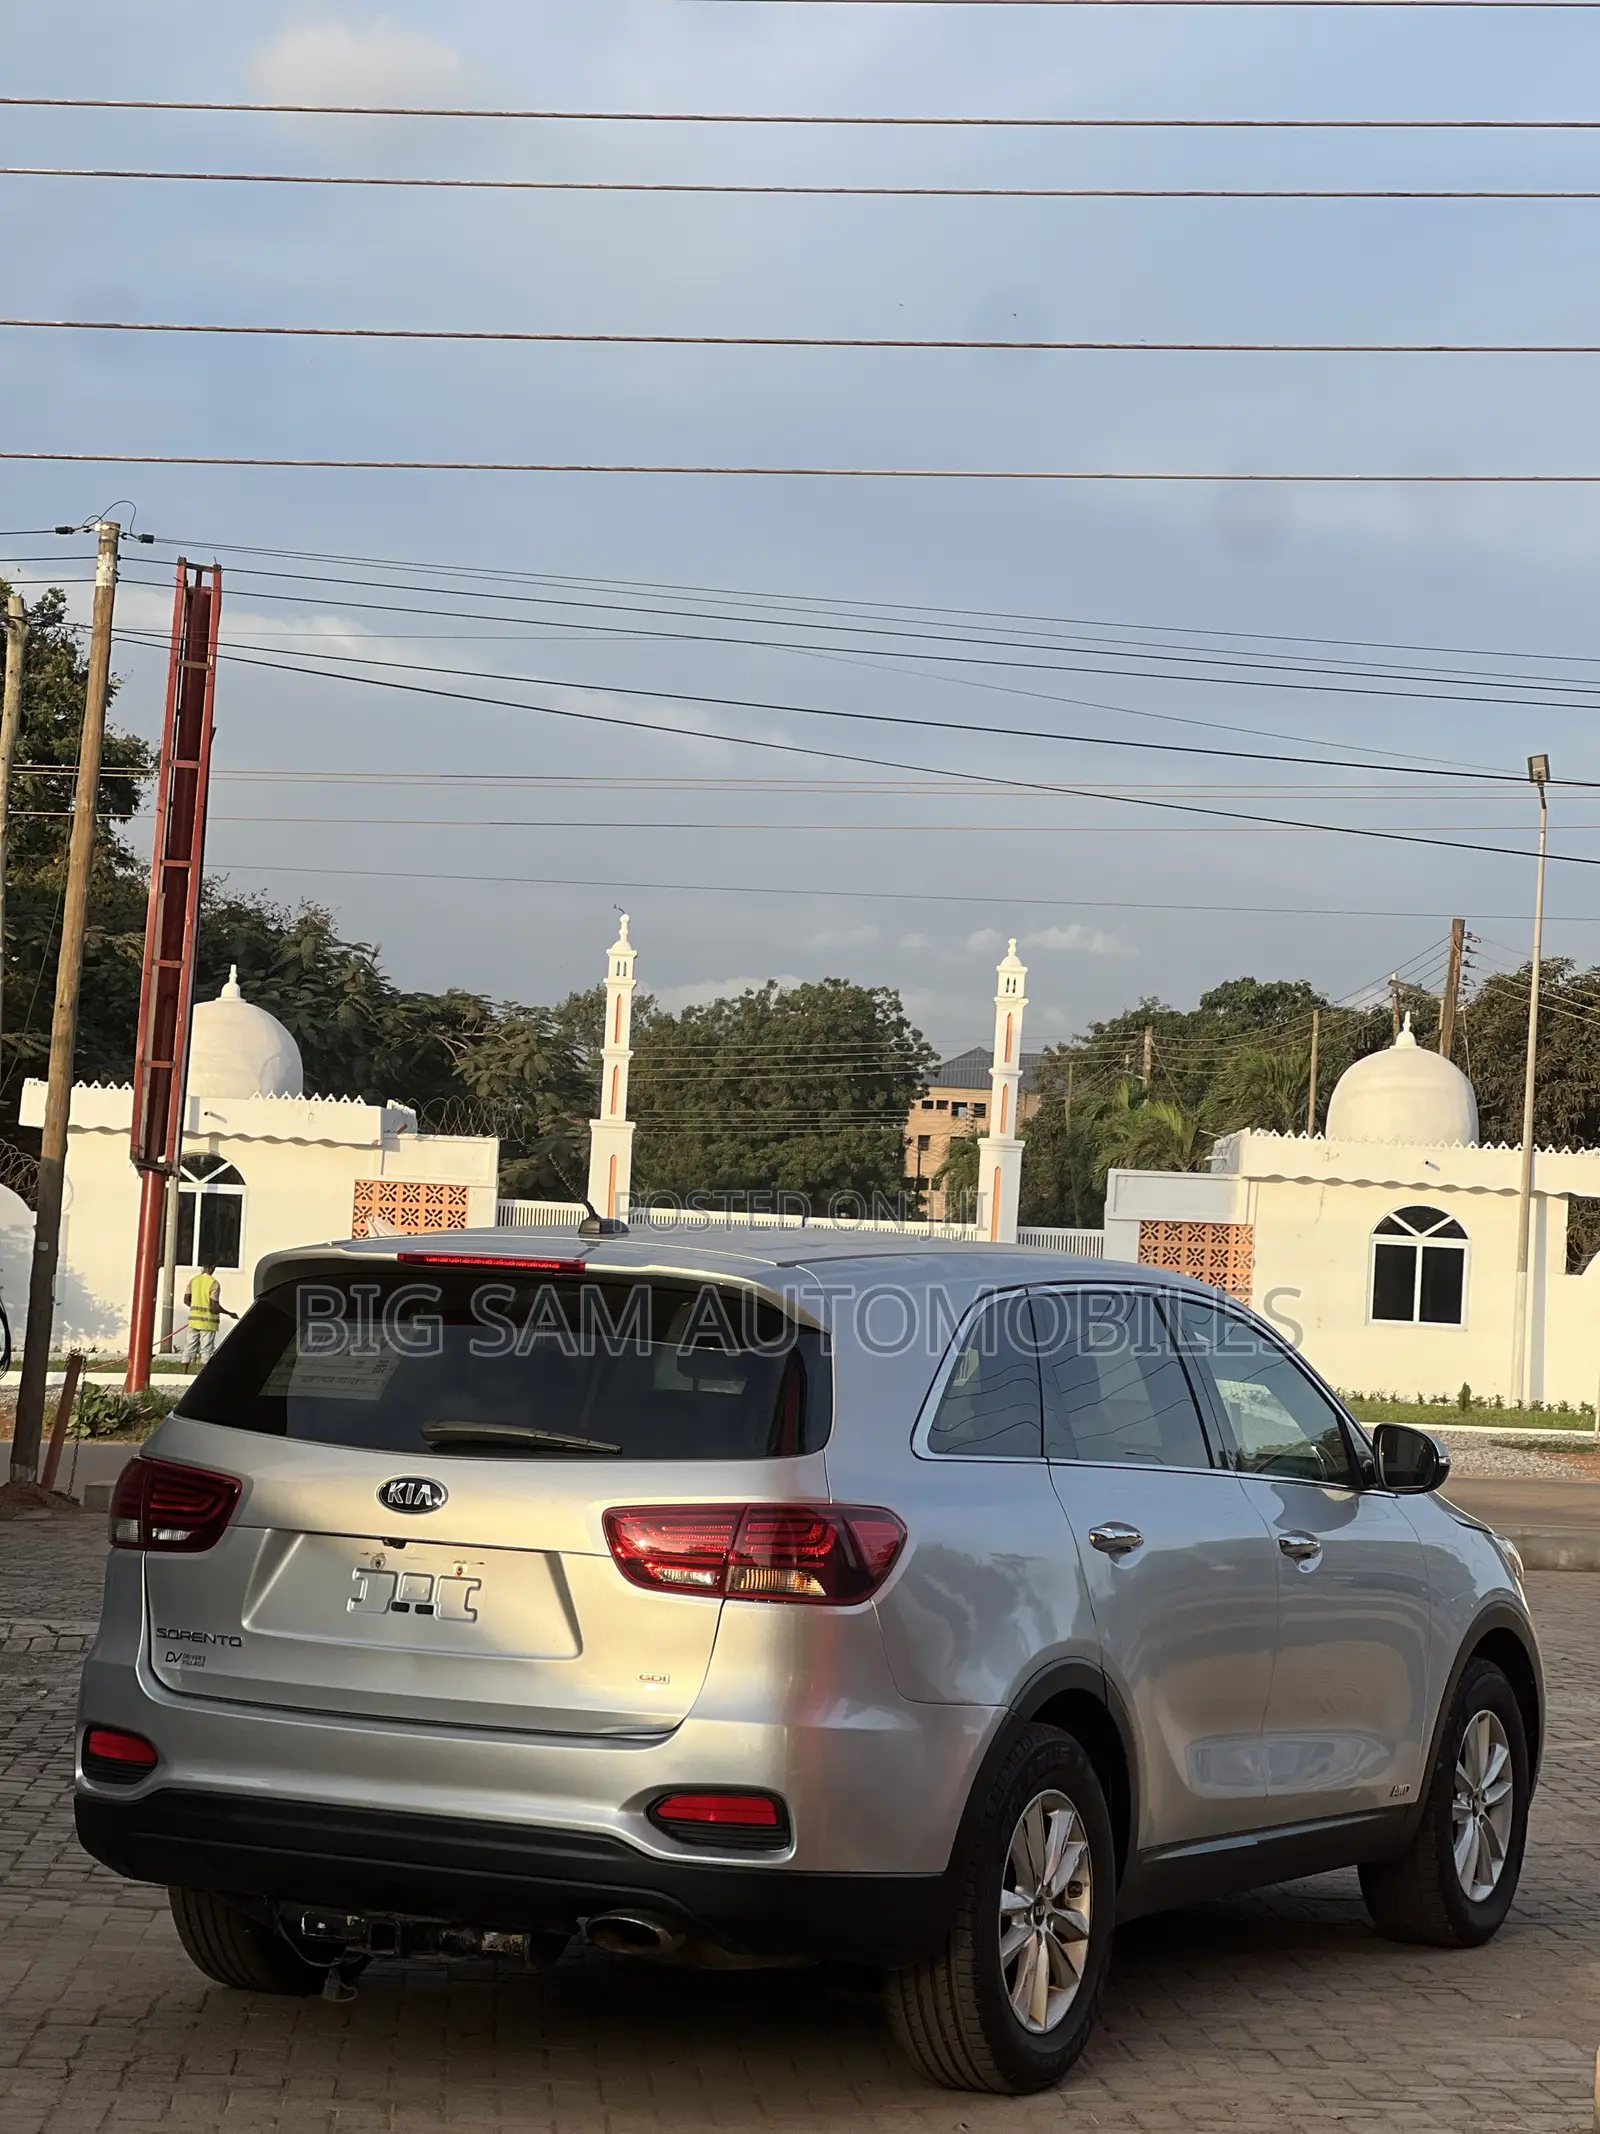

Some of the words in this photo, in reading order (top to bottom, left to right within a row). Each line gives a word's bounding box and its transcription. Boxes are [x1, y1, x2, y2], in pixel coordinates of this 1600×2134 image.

[387, 1482, 432, 1506] KIA
[156, 1627, 243, 1648] SORENTO
[165, 1651, 183, 1663] DV
[639, 1674, 667, 1682] GDI
